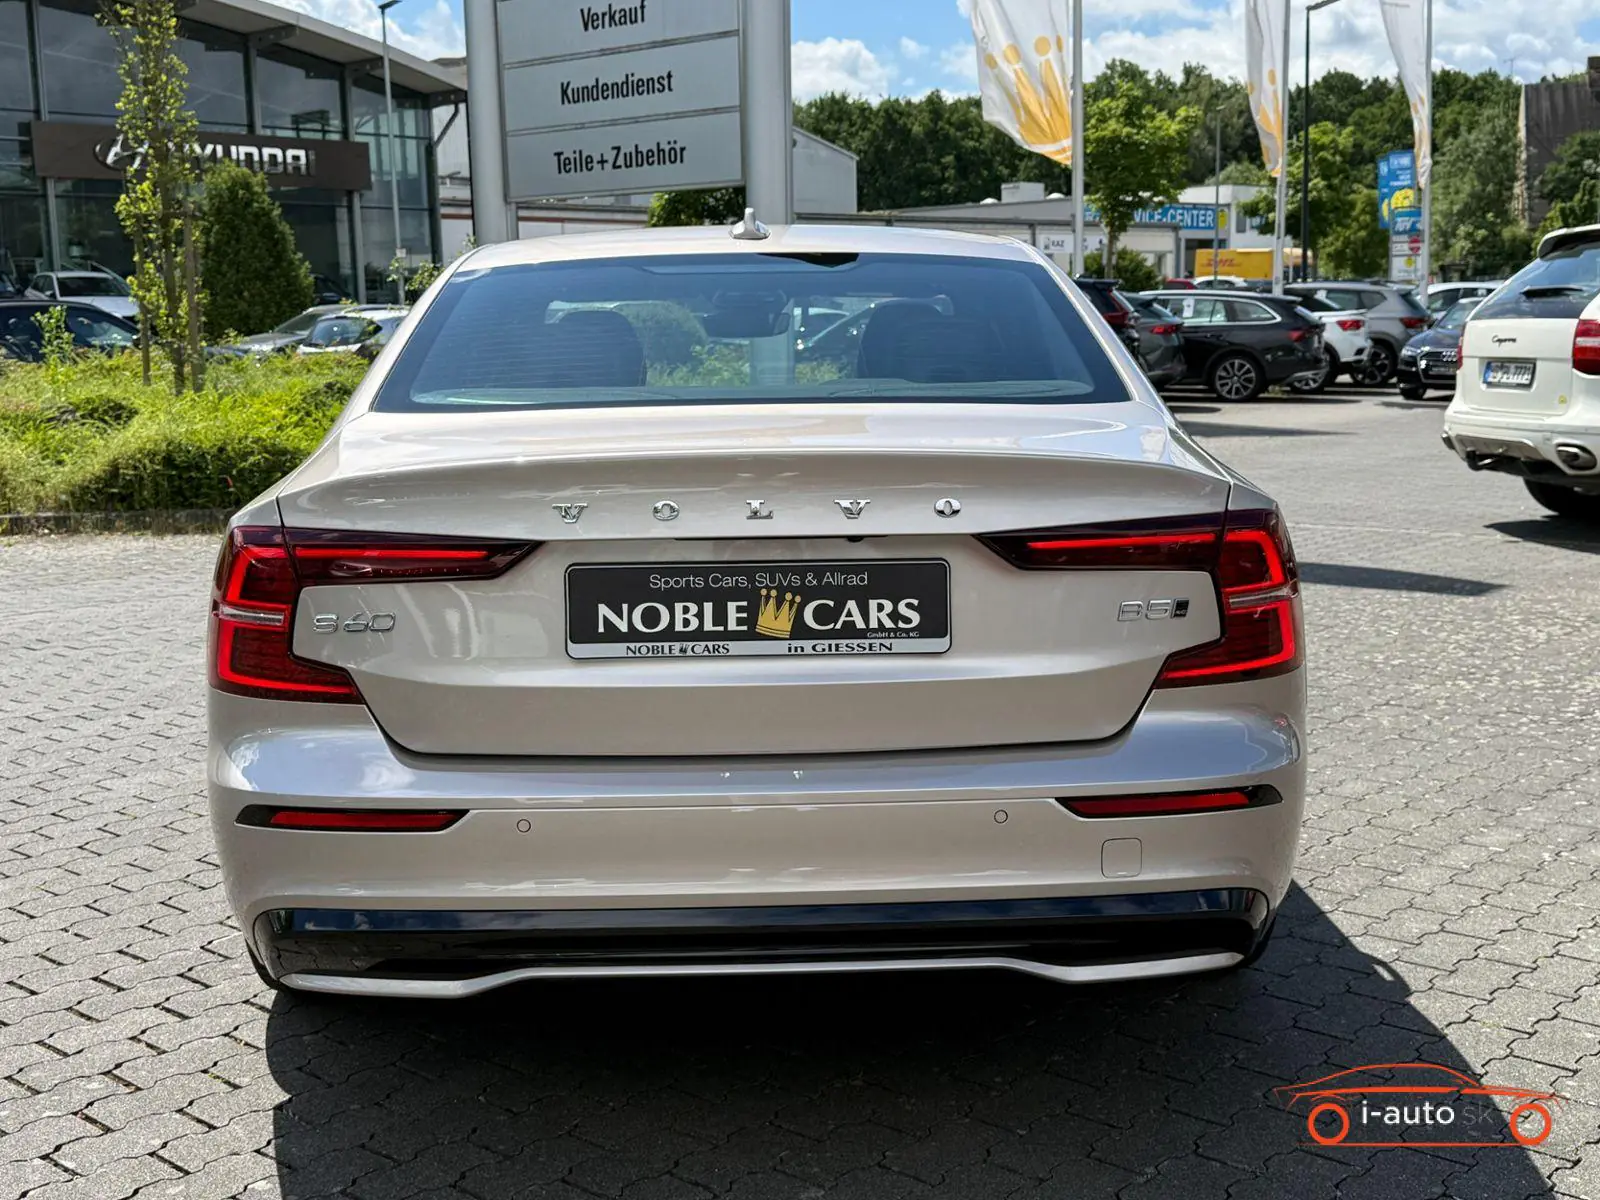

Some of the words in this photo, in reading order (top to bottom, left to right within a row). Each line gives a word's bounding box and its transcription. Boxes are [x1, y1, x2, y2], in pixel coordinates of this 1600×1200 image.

[580, 0, 647, 32] Verkauf
[560, 70, 673, 105] Kundendienst
[166, 141, 317, 176] YUNDAI
[553, 140, 687, 175] Teile+Zubehör
[552, 497, 962, 525] VOLVO
[649, 574, 704, 591] Sports
[708, 573, 751, 588] Cars,
[755, 571, 801, 587] SUVs
[805, 572, 818, 586] &
[822, 571, 868, 586] Allrad
[597, 600, 749, 634] NOBLE
[803, 598, 921, 630] CARS
[626, 644, 676, 656] NOBLE
[690, 643, 730, 655] CARS
[787, 642, 805, 653] in
[811, 642, 893, 653] GIESSEN
